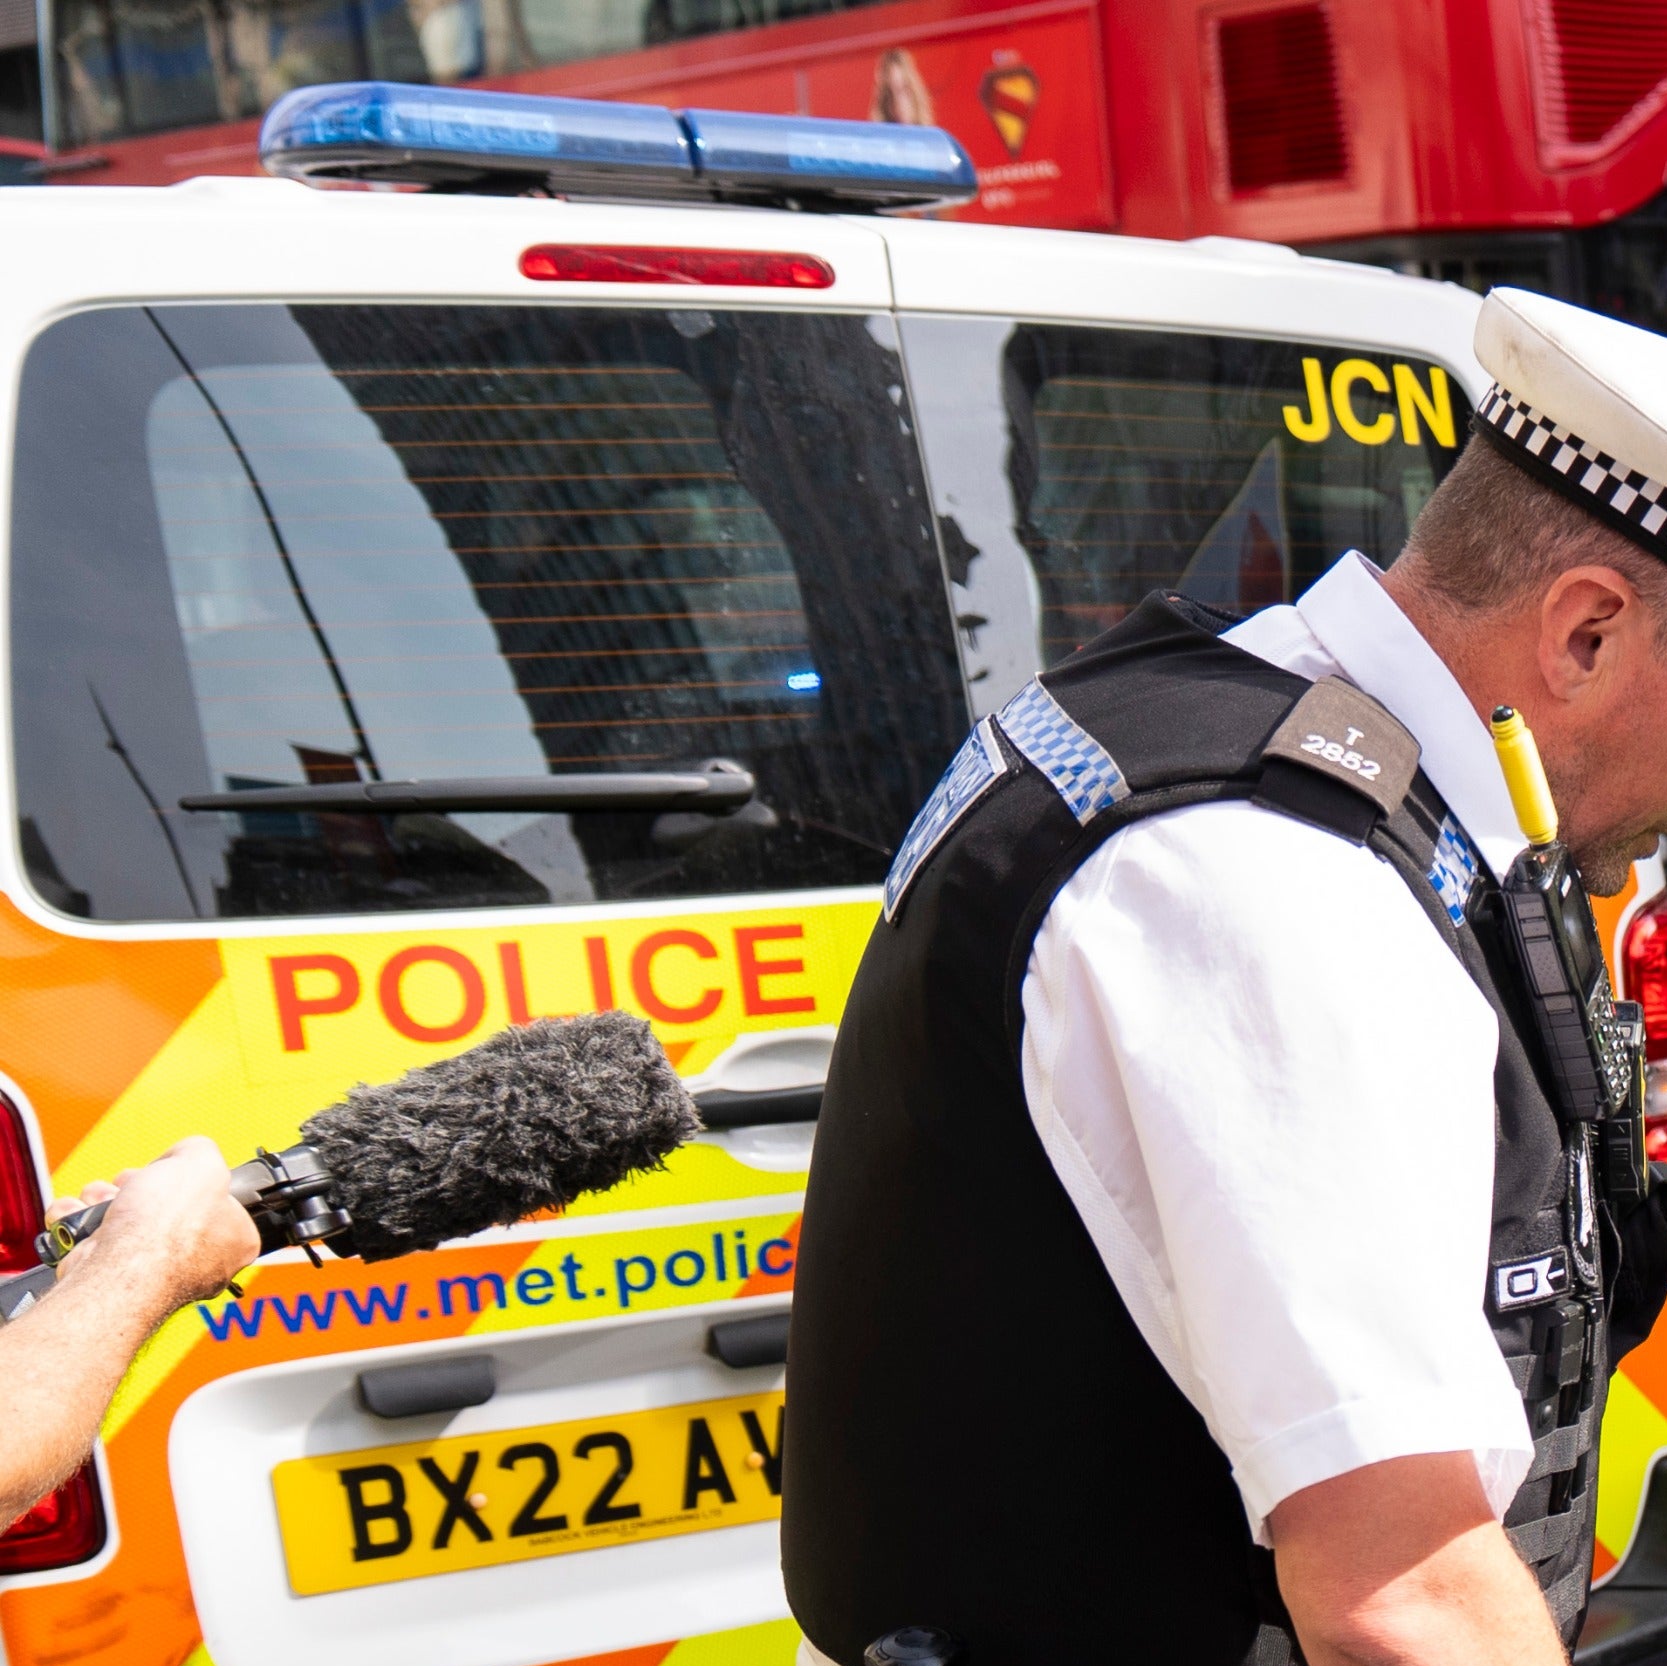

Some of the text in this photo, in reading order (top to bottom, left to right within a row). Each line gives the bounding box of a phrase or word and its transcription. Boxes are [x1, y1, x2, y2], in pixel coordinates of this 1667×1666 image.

[1282, 357, 1457, 448] JCN
[1300, 734, 1381, 782] 2852
[1345, 726, 1365, 746] T
[268, 923, 817, 1053] POLICE
[338, 1431, 642, 1562] BX22
